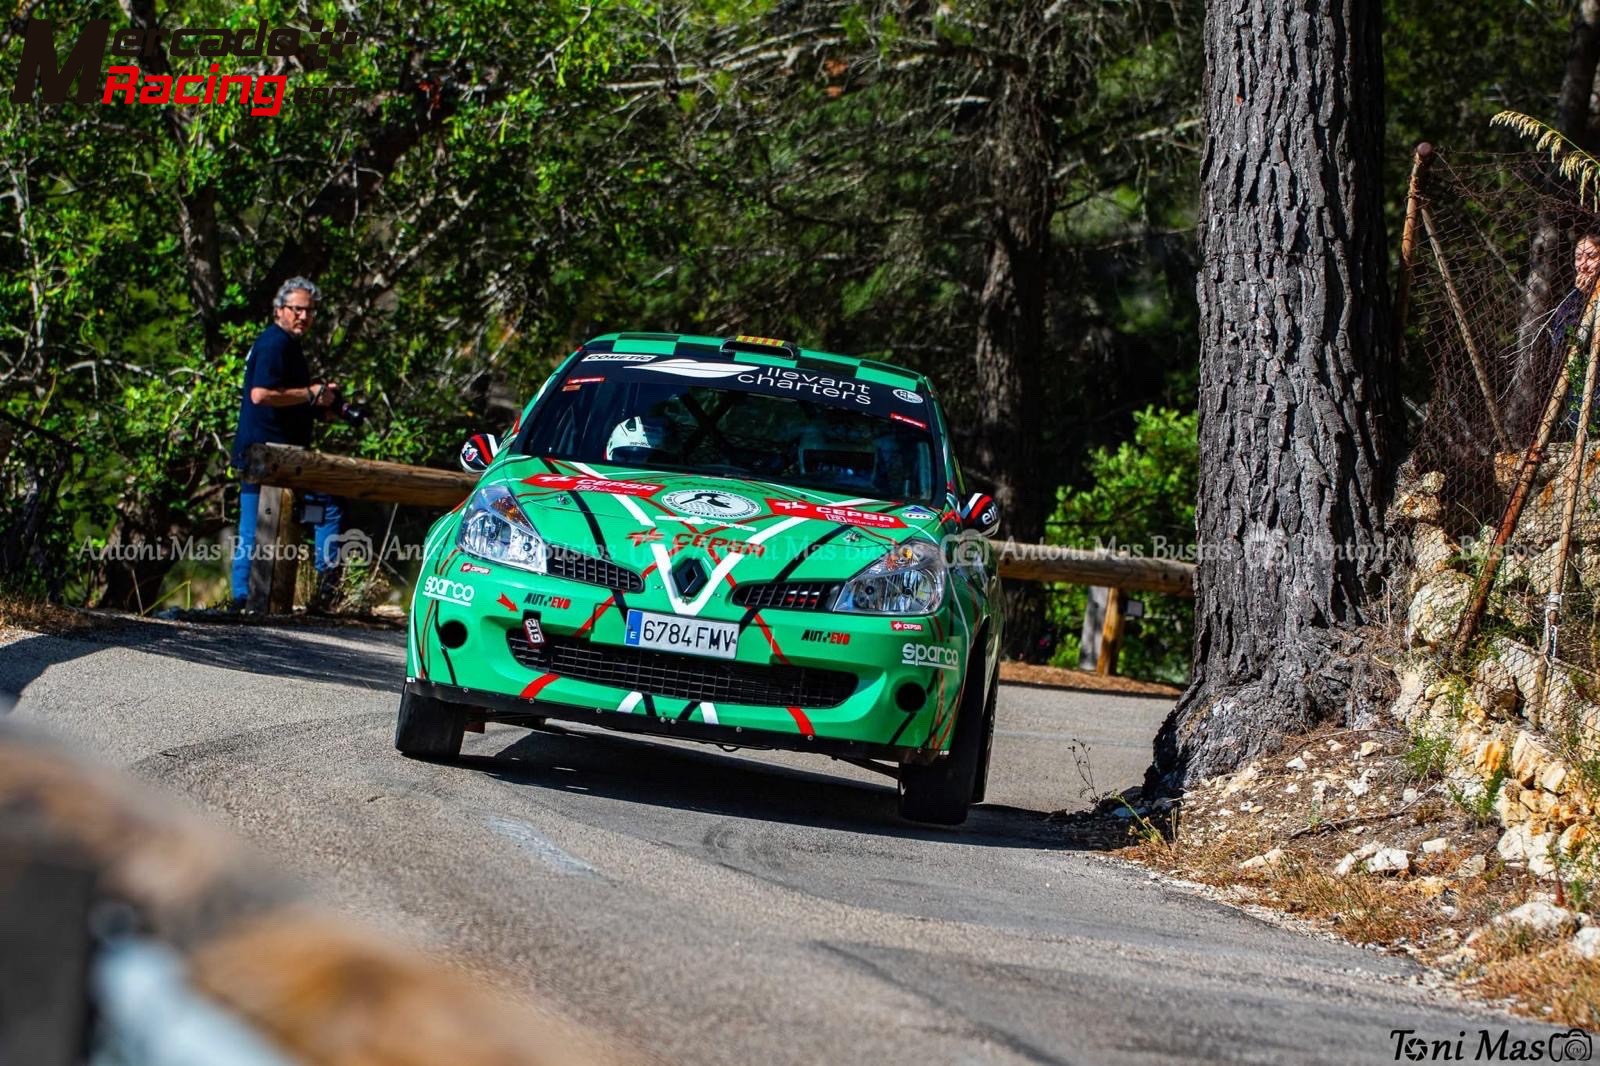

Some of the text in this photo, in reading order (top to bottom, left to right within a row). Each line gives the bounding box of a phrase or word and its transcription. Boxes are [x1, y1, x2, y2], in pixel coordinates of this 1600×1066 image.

[737, 374, 872, 405] charters
[767, 367, 871, 394] llevant
[816, 506, 895, 523] CEPSA
[673, 533, 765, 558] CEPSA
[424, 576, 475, 602] sparco
[630, 631, 637, 639] E
[902, 642, 959, 666] sparco
